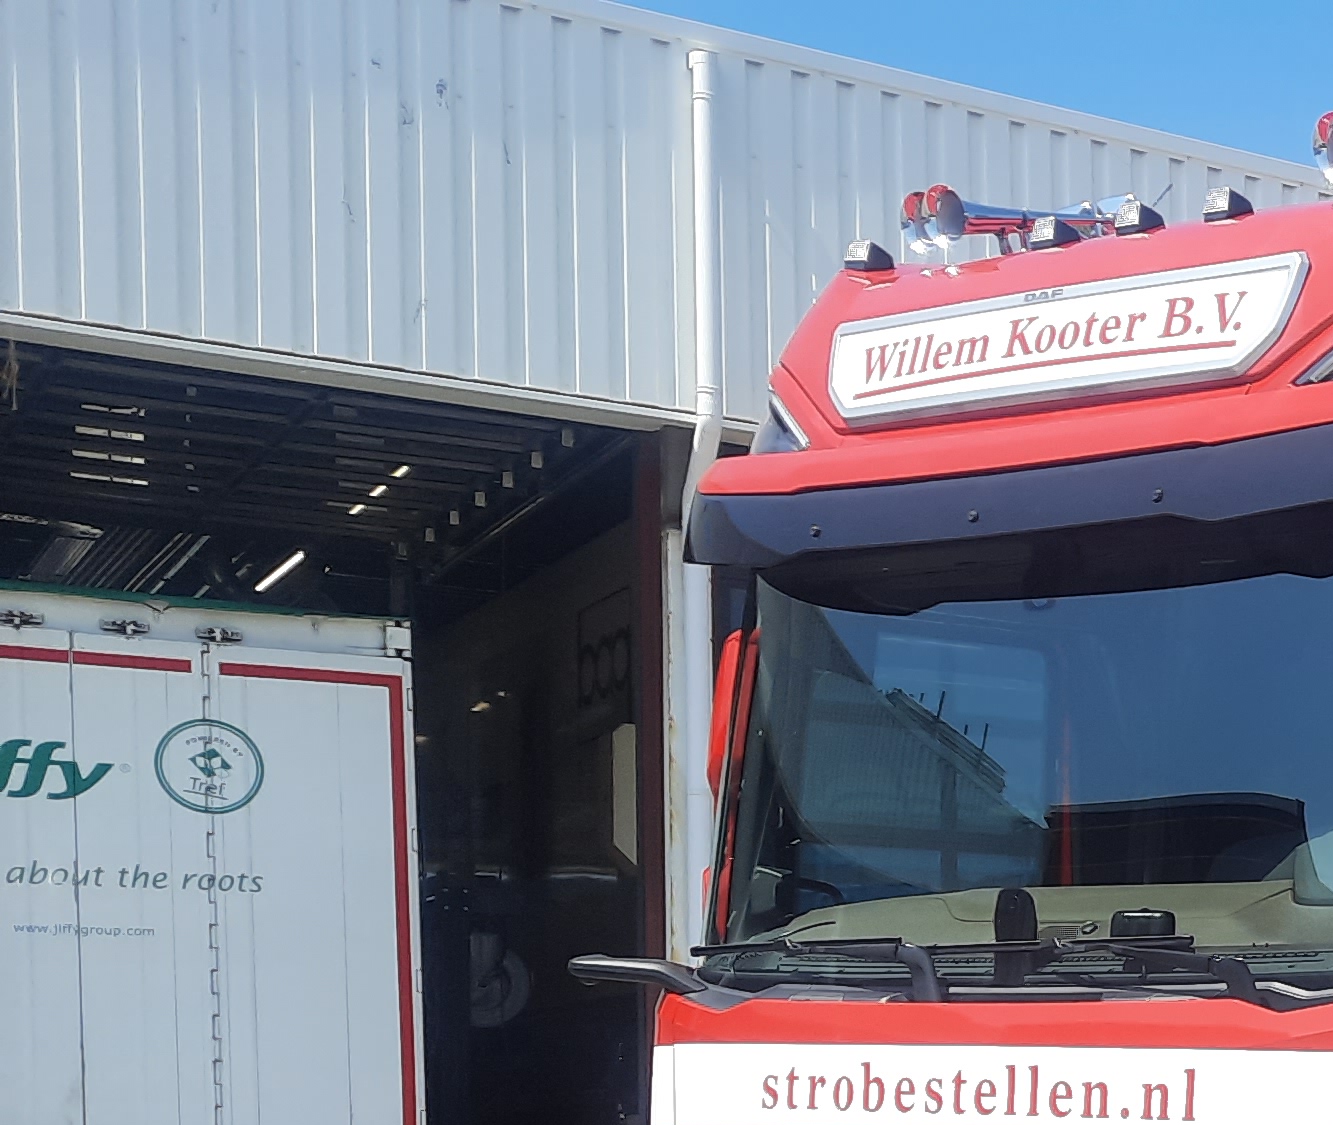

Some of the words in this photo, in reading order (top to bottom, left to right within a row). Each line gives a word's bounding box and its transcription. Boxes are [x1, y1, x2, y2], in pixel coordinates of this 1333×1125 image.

[1024, 288, 1064, 302] DAF
[865, 334, 989, 385] Willem
[1001, 312, 1147, 359] Kooter
[1157, 291, 1249, 339] B.V.
[6, 860, 105, 888] about
[118, 864, 168, 890] the
[182, 872, 264, 893] roots
[761, 1062, 1196, 1121] strobestellen.nl
